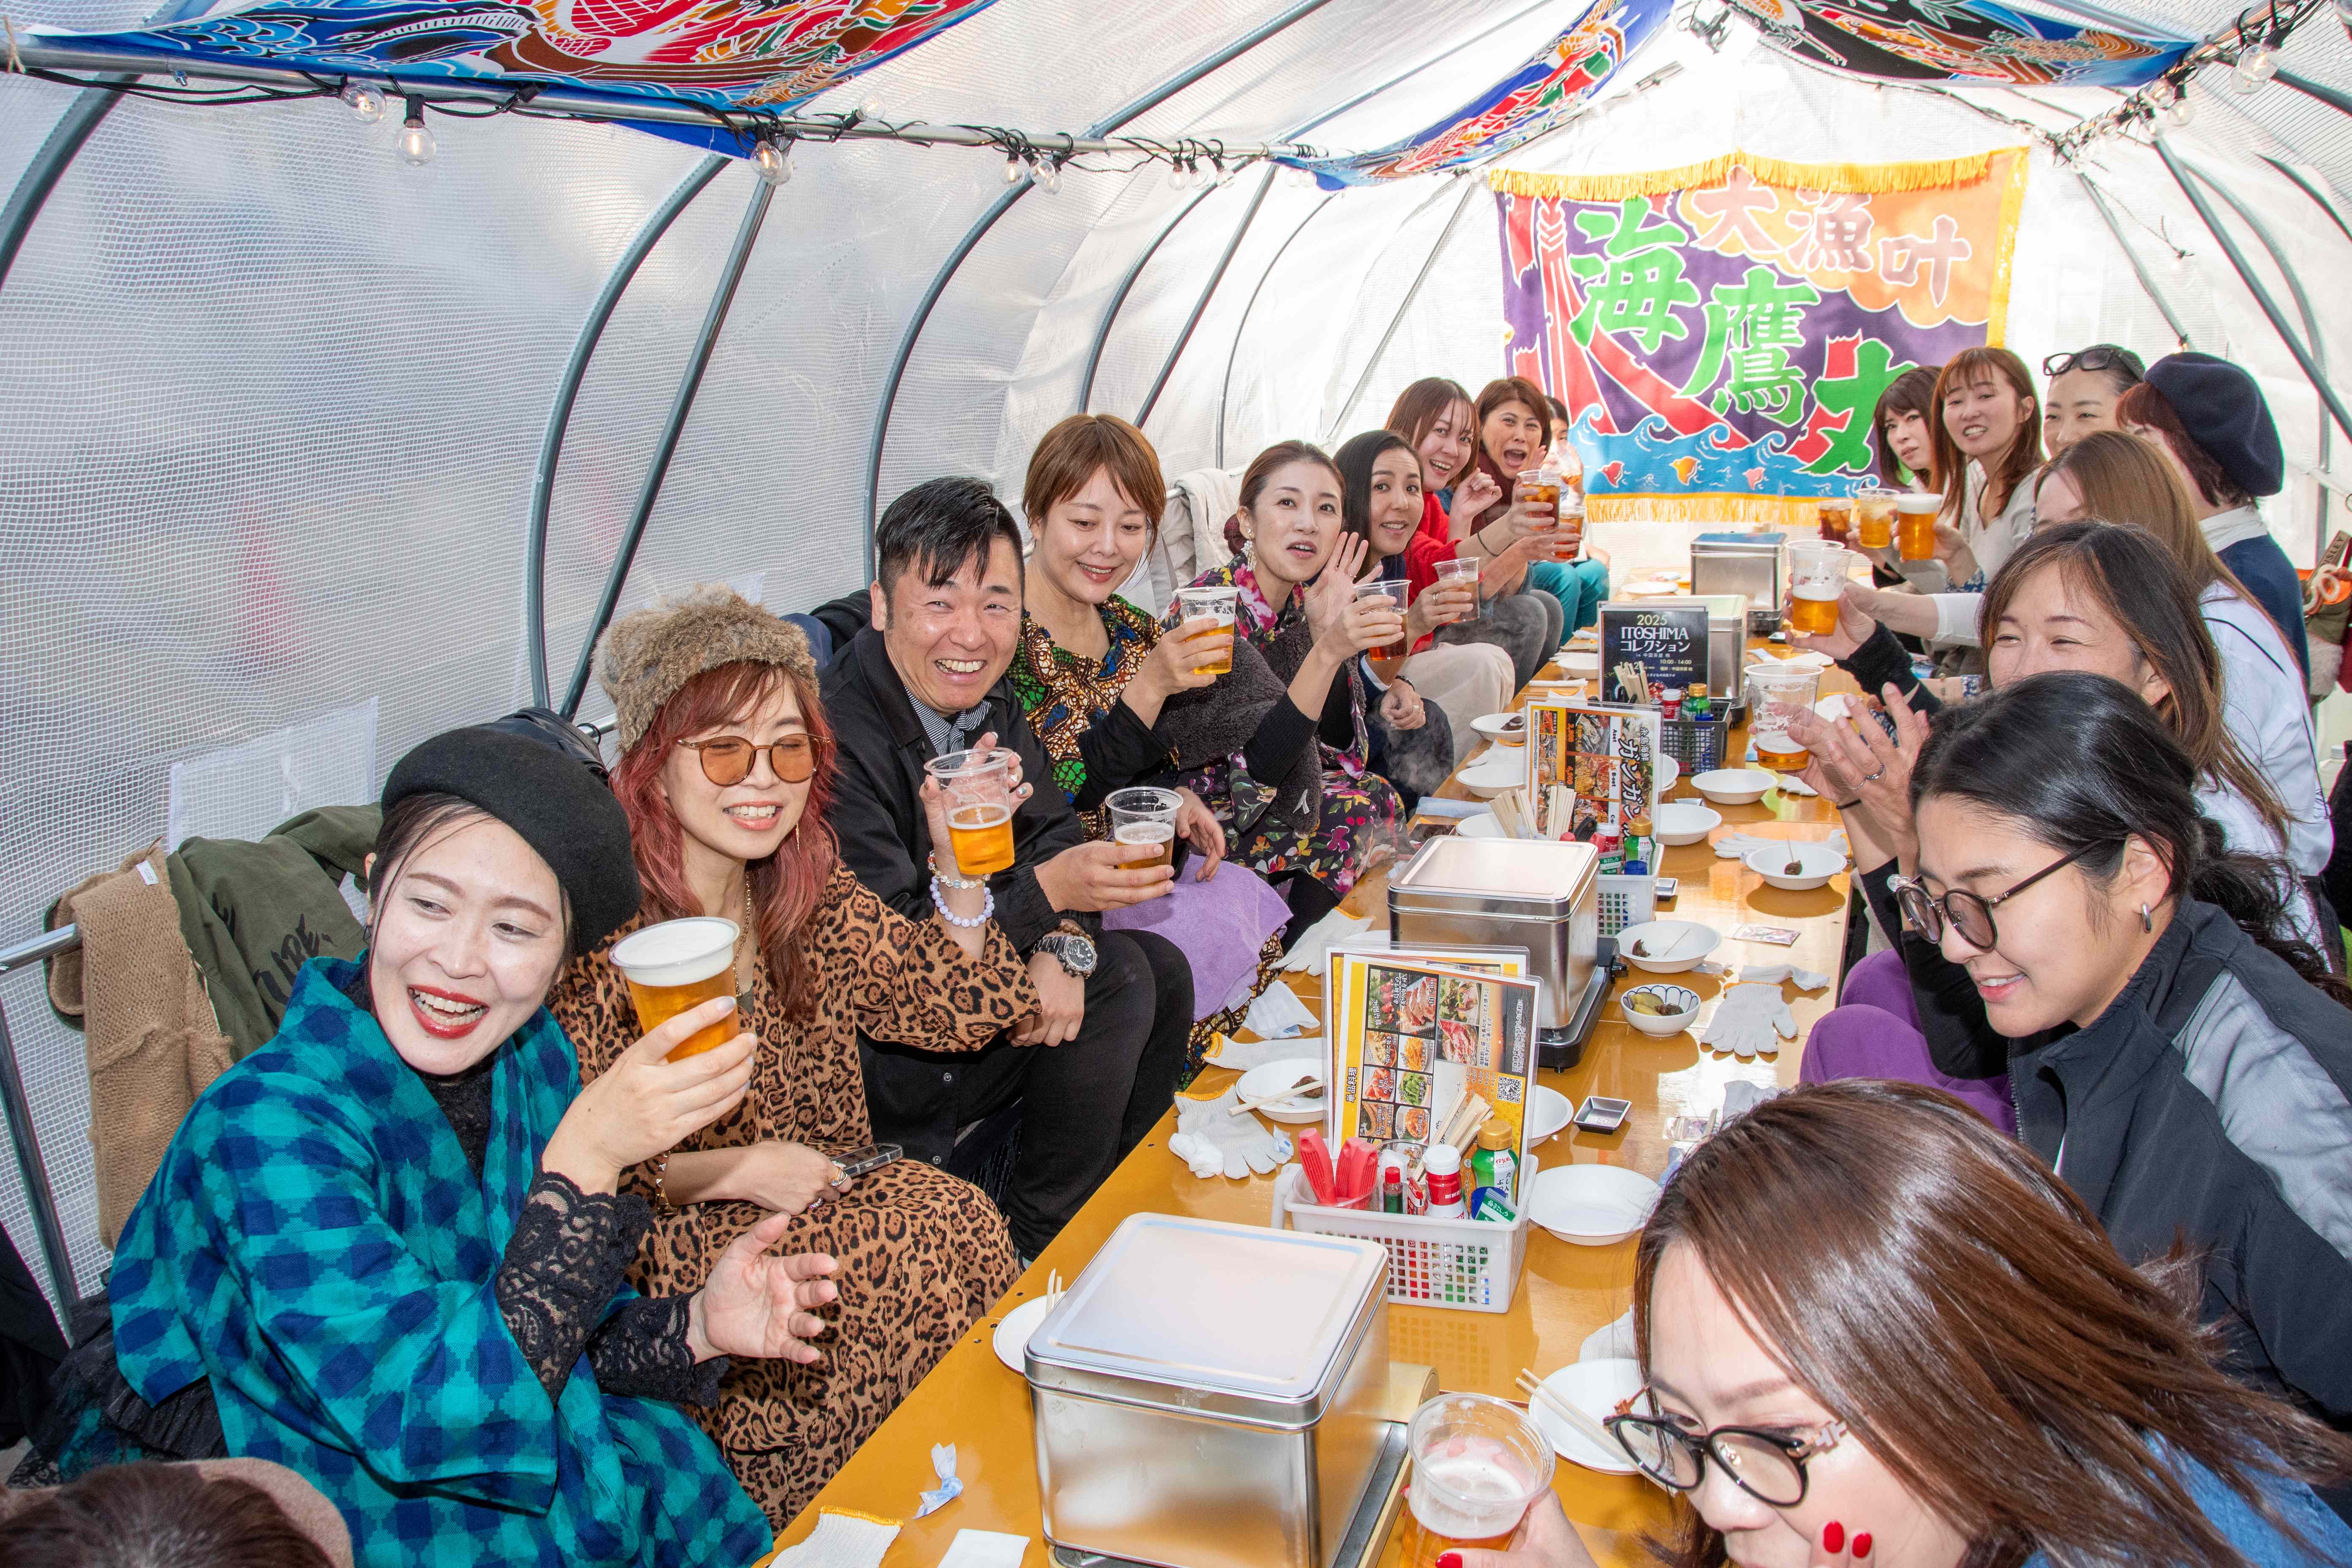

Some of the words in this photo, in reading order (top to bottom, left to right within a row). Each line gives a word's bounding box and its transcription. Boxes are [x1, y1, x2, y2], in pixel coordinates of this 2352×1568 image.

[1637, 614, 1668, 626] 2025
[1621, 626, 1690, 640] ITOSHIMA
[1620, 640, 1690, 653] コレクション
[1372, 999, 1381, 1026] 数量限定
[1346, 1067, 1357, 1102] 単品料理
